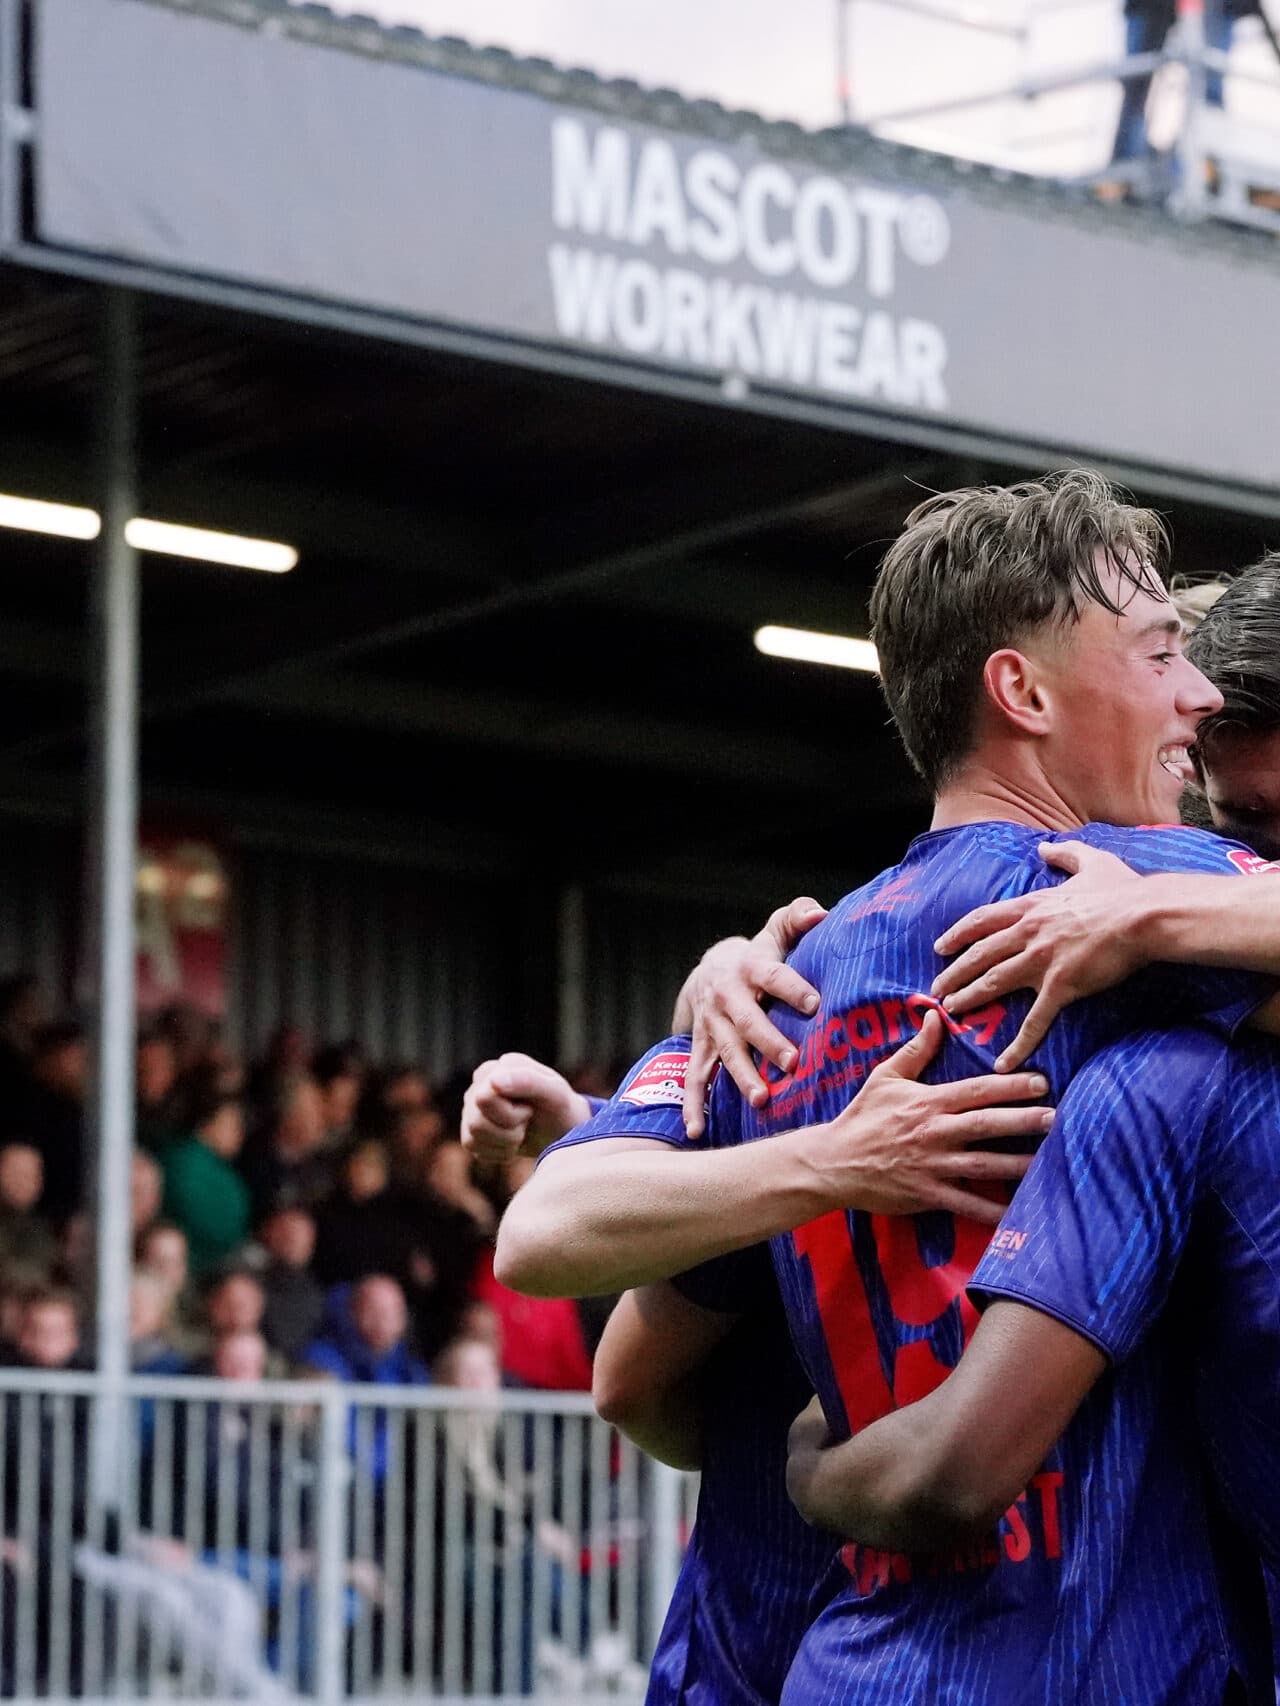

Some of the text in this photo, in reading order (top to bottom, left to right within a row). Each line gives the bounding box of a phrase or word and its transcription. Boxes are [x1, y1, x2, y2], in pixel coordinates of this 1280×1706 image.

[547, 243, 949, 413] WORKWEAR
[653, 1061, 690, 1070] Keuk
[640, 1069, 689, 1080] Kampi
